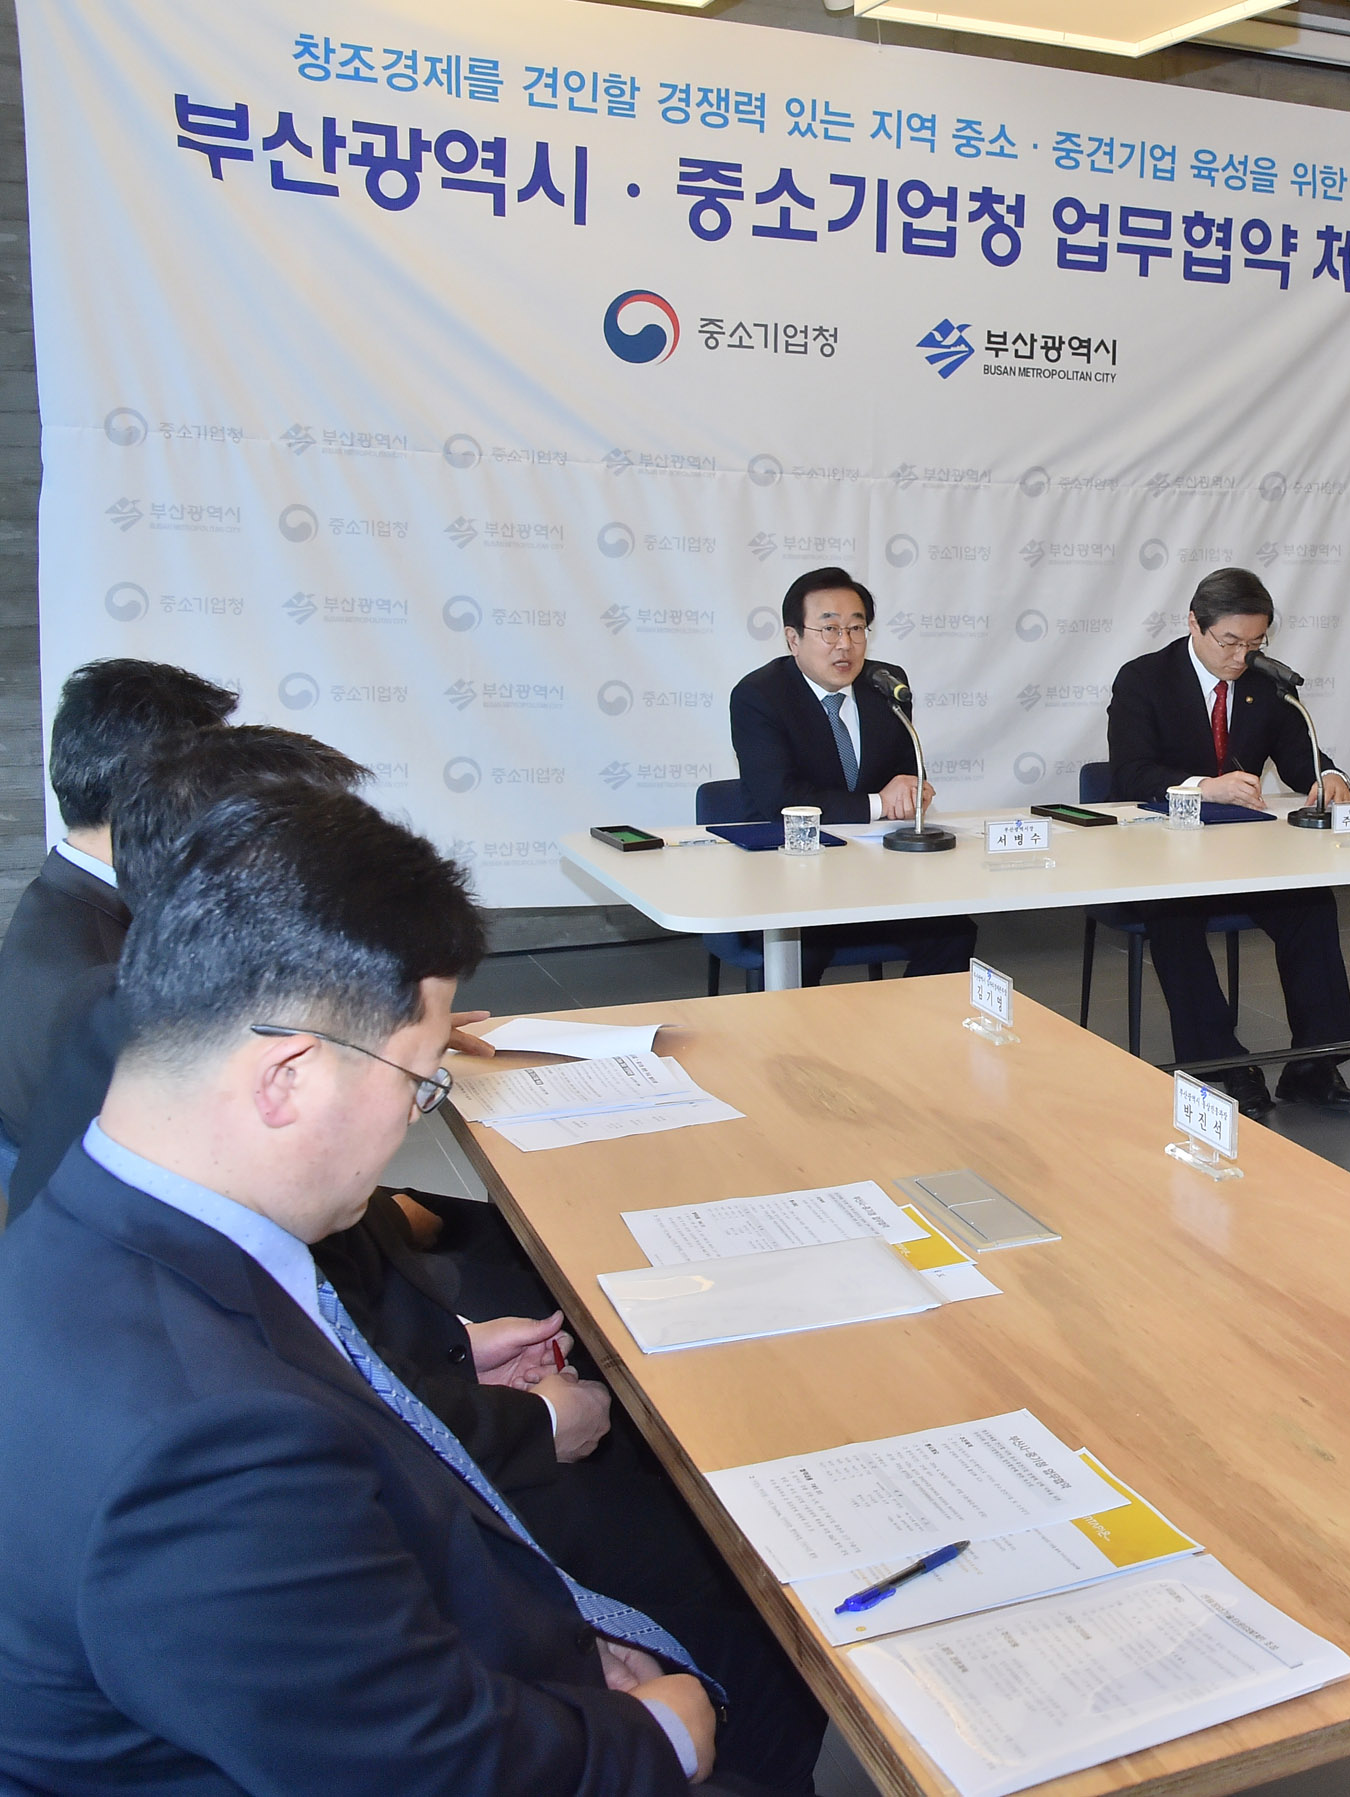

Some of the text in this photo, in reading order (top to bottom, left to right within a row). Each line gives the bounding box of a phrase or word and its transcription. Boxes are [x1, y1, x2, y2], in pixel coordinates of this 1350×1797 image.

[292, 33, 504, 103] 창조경제를
[522, 64, 640, 119] 견인할
[657, 81, 767, 133] 경쟁력
[784, 97, 855, 143] 있는
[870, 107, 938, 153] 지역
[952, 119, 1019, 161] 중소
[1051, 131, 1177, 183] 중견기업
[1190, 149, 1277, 195] 육성을
[1290, 162, 1347, 202] 위한
[174, 94, 588, 226] 부산광역시
[676, 157, 1026, 268] 중소기업청
[1053, 197, 1299, 291] 업무협약
[698, 317, 838, 358] 중소기업청
[984, 330, 1118, 366] 부산광역시
[983, 365, 1117, 383] BUSAN METROPOLITAN CITY
[150, 502, 241, 523] 부산광역시
[328, 517, 408, 538] 중소기업청
[484, 520, 564, 540] 부산광역시
[643, 534, 716, 553] 중소기업청
[783, 535, 856, 553] 부산광역시
[928, 544, 992, 562] 중소기업청
[1049, 543, 1116, 558] 부산광역시
[159, 594, 245, 616] 중소기업청
[322, 596, 408, 616] 부산광역시
[491, 608, 567, 627] 중소기업청
[637, 608, 715, 627] 부산광역시
[920, 614, 990, 631] 부산광역시
[330, 684, 409, 703] 중소기업청
[482, 682, 565, 700] 부산광역시
[642, 690, 713, 708] 중소기업청
[491, 767, 566, 785] 중소기업청
[636, 763, 713, 780] 부산광역시
[997, 832, 1041, 847] 서병수
[1183, 1103, 1222, 1140] 박진석
